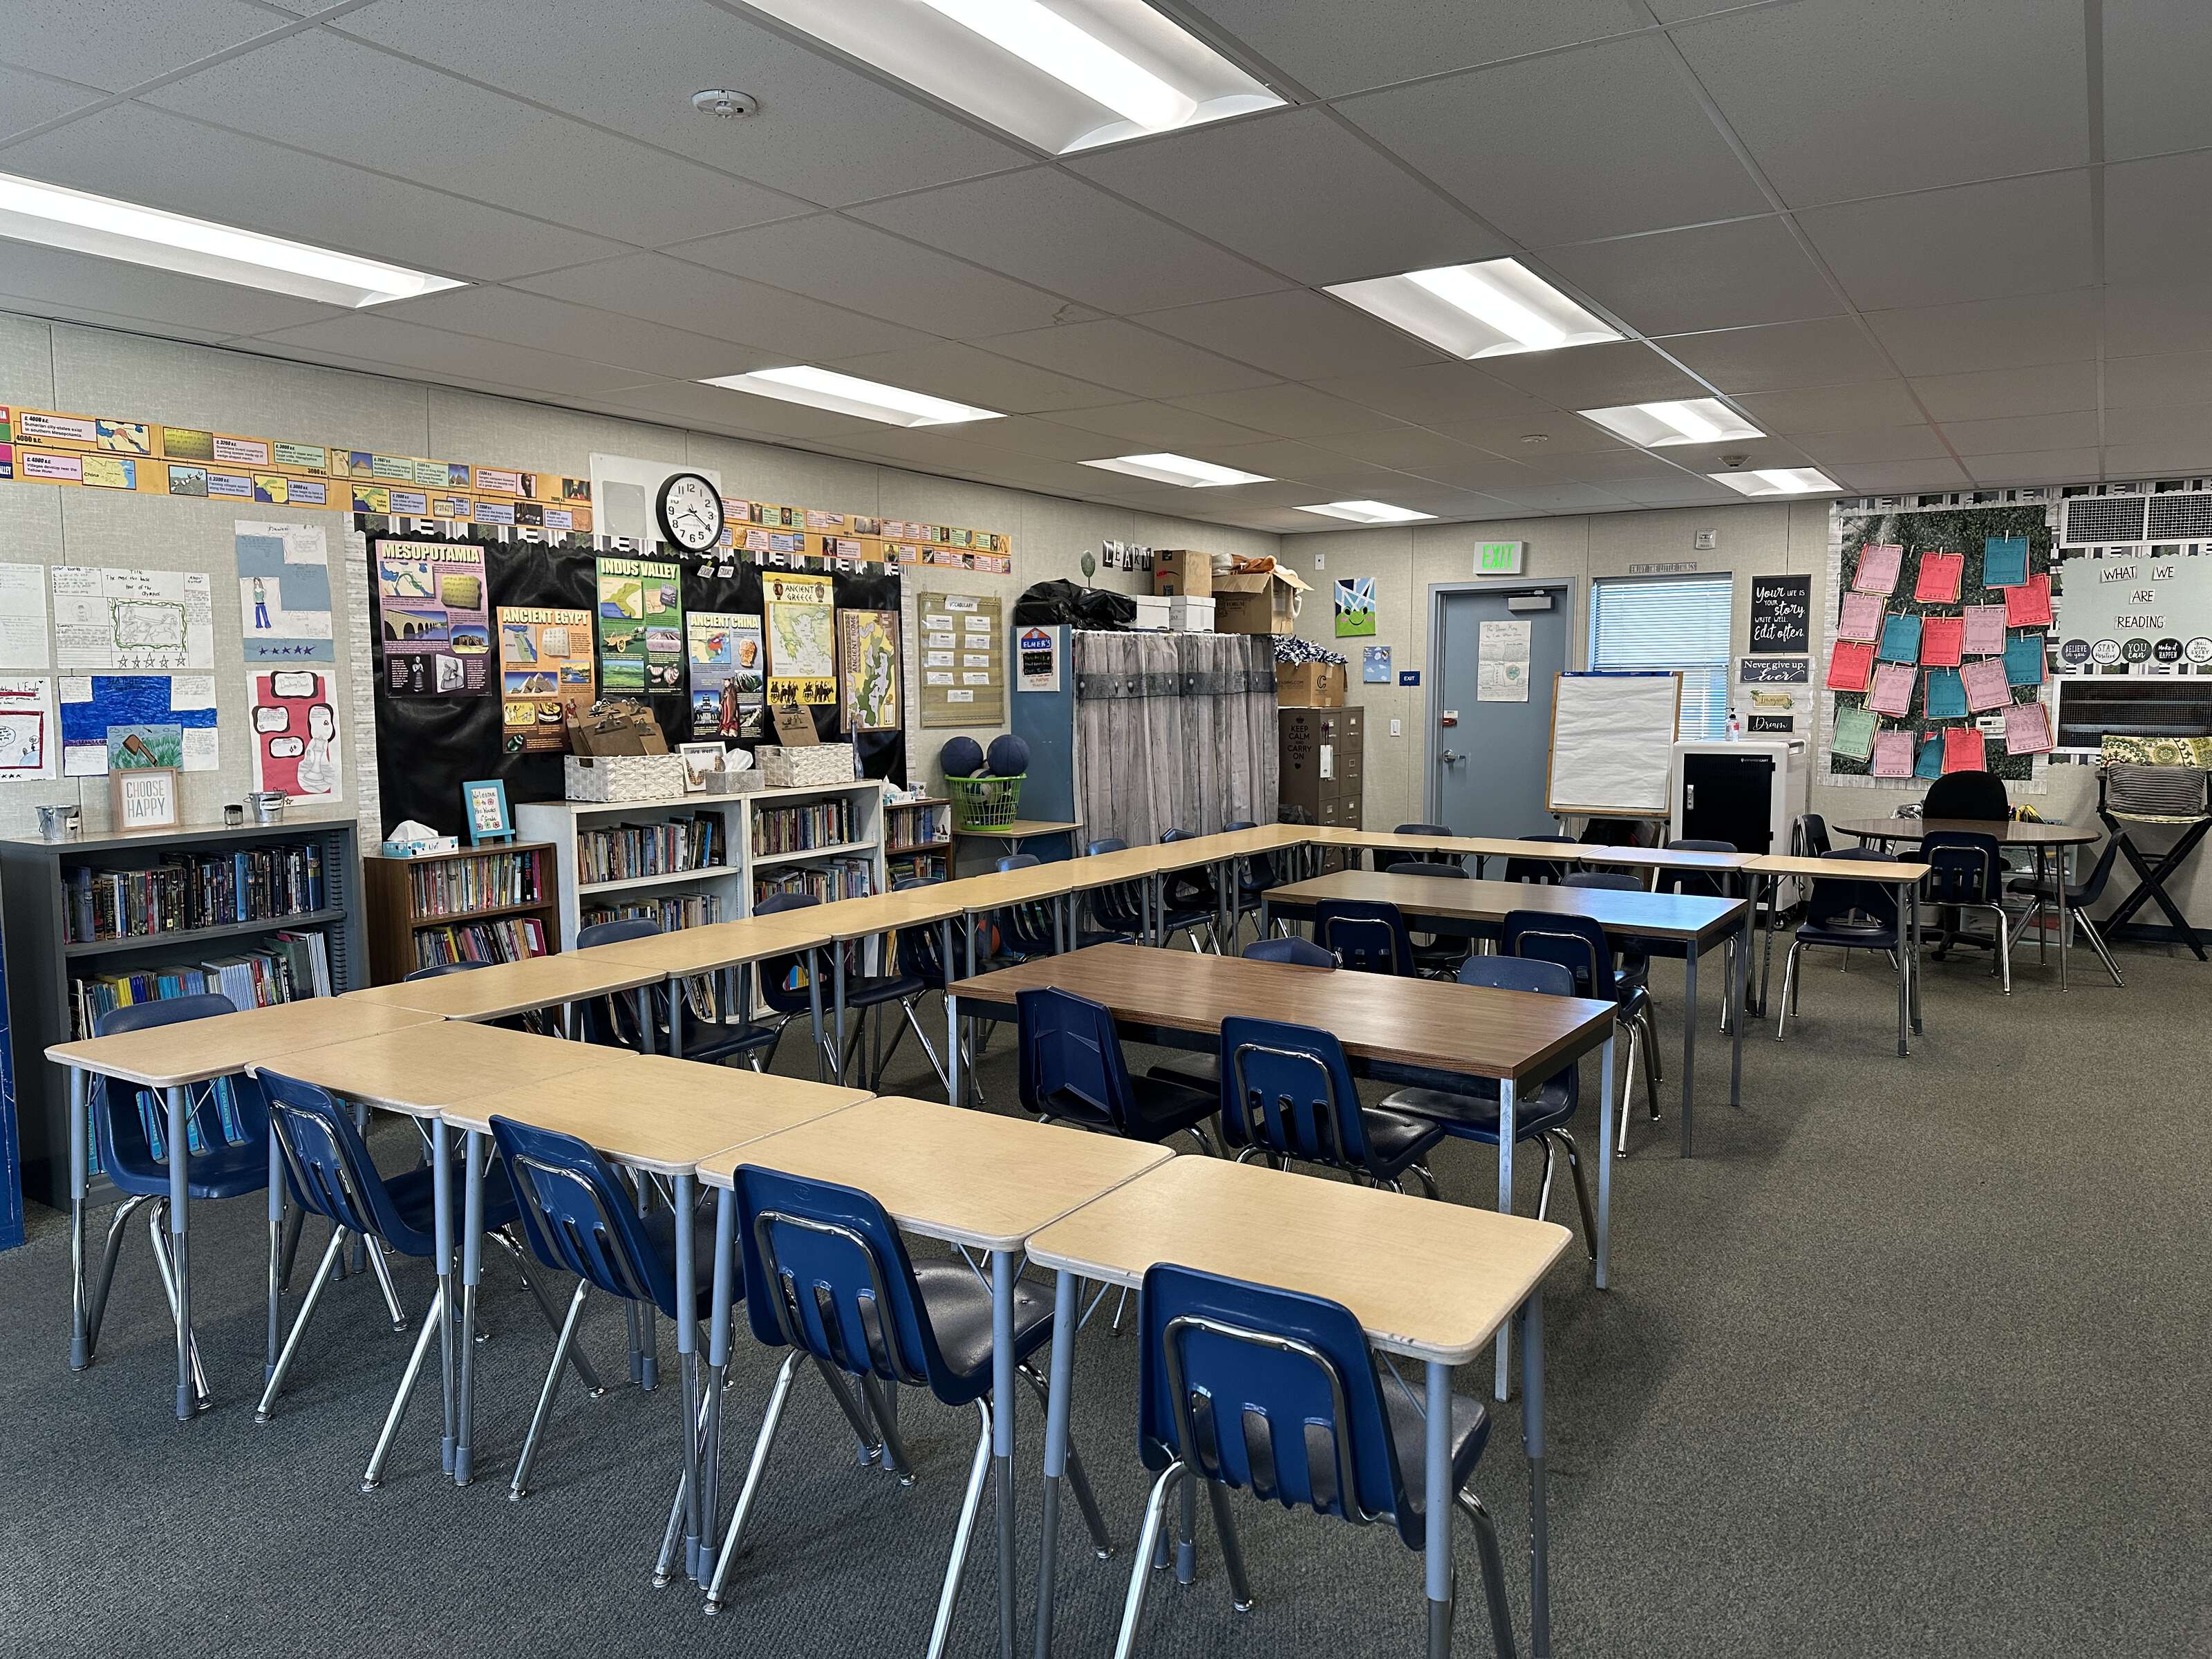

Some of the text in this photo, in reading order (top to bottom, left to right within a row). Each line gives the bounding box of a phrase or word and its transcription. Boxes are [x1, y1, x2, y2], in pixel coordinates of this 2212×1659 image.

[16, 434, 32, 442] 4000
[678, 485, 684, 494] 11
[687, 483, 695, 492] 12
[705, 499, 711, 507] 2
[668, 506, 675, 515] 9
[708, 511, 714, 520] 3
[673, 520, 679, 529] 8
[679, 529, 686, 538] 7
[690, 534, 695, 543] 6
[698, 531, 704, 540] 5
[382, 543, 480, 563] MESOPOTAMIA
[1105, 544, 1150, 568] LEARN
[1483, 544, 1515, 569] EXIT
[601, 559, 677, 579] INDUS VALLEY
[1631, 563, 1696, 573] ENJOY THE LITTLE THINGS
[2103, 566, 2174, 579] WHAT WE
[785, 585, 814, 594] ANCIENT
[1756, 587, 1785, 603] Your
[2133, 590, 2154, 603] ARE
[503, 609, 589, 626] ANCIENT EGYPT
[691, 614, 758, 629] ANCIENT CHINA
[2117, 615, 2164, 628] READING
[1754, 624, 1774, 641] Edit
[1023, 639, 1051, 648] ELMER'S
[2098, 644, 2115, 652] STAY
[2128, 643, 2147, 652] YOU
[1772, 661, 1790, 670] give
[1792, 662, 1806, 671] up.
[1753, 717, 1787, 730] Dream
[126, 779, 164, 798] CHOOSE
[128, 797, 165, 818] HAPPY
